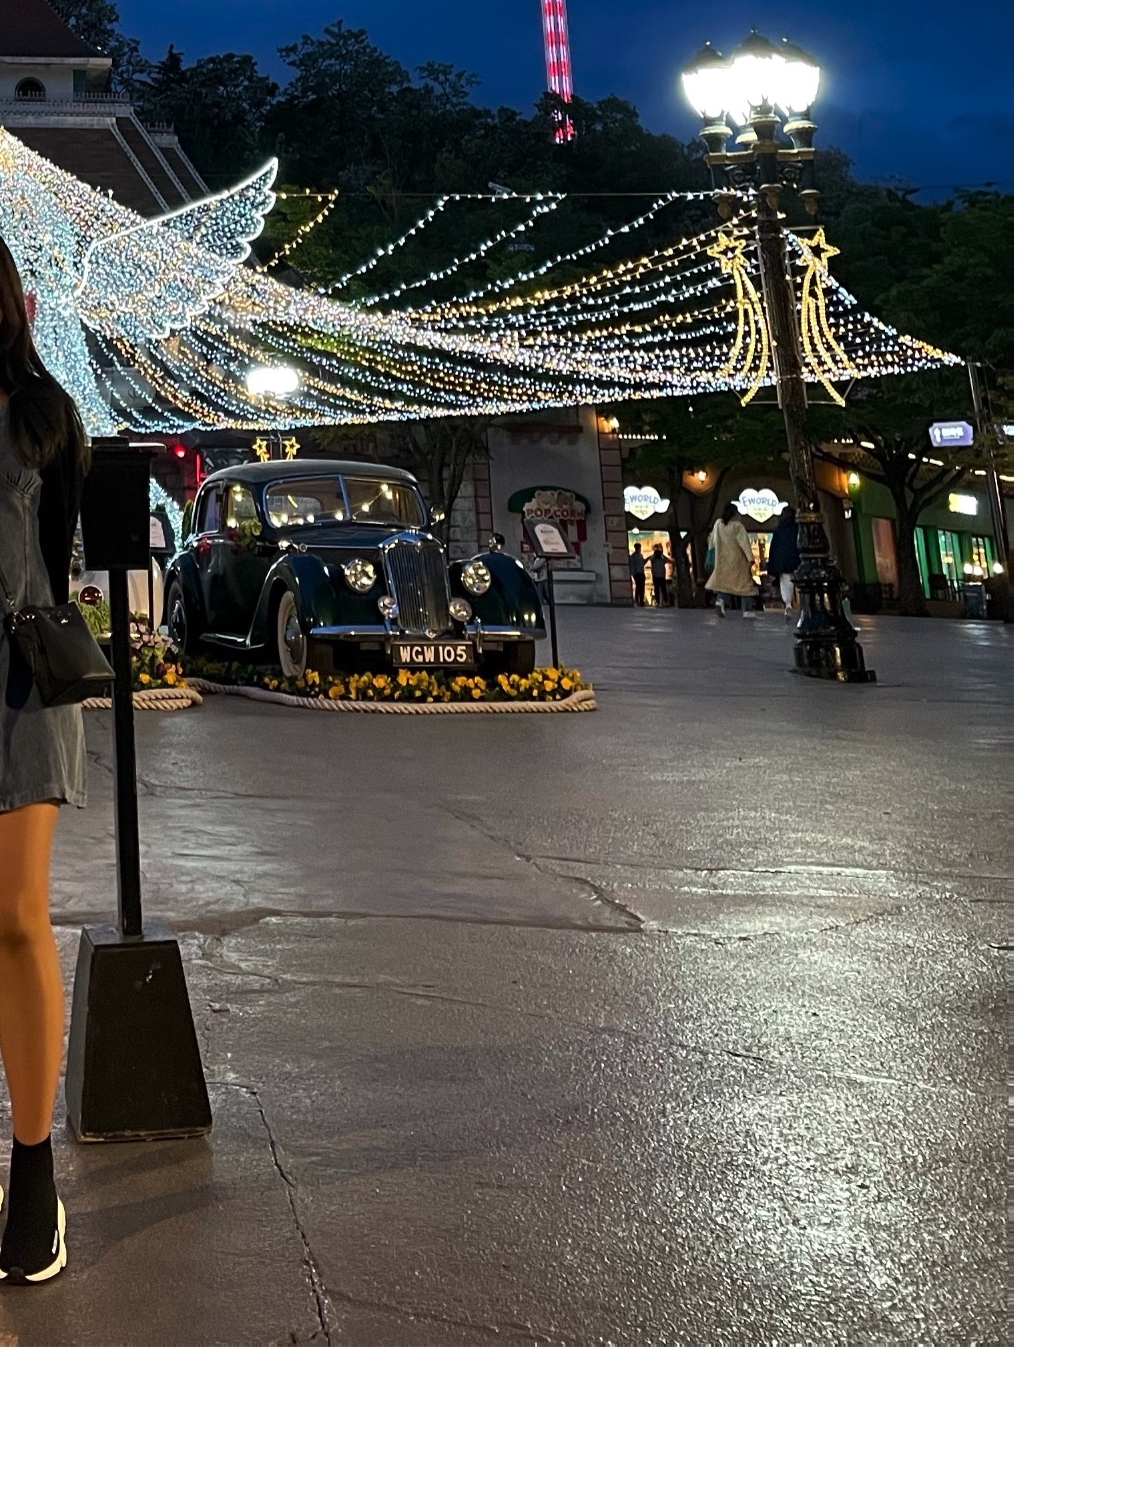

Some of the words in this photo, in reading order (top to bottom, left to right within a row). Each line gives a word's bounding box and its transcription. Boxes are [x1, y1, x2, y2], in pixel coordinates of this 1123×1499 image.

[742, 495, 777, 507] EWORLD
[399, 645, 435, 663] WGW
[438, 645, 467, 663] 105
